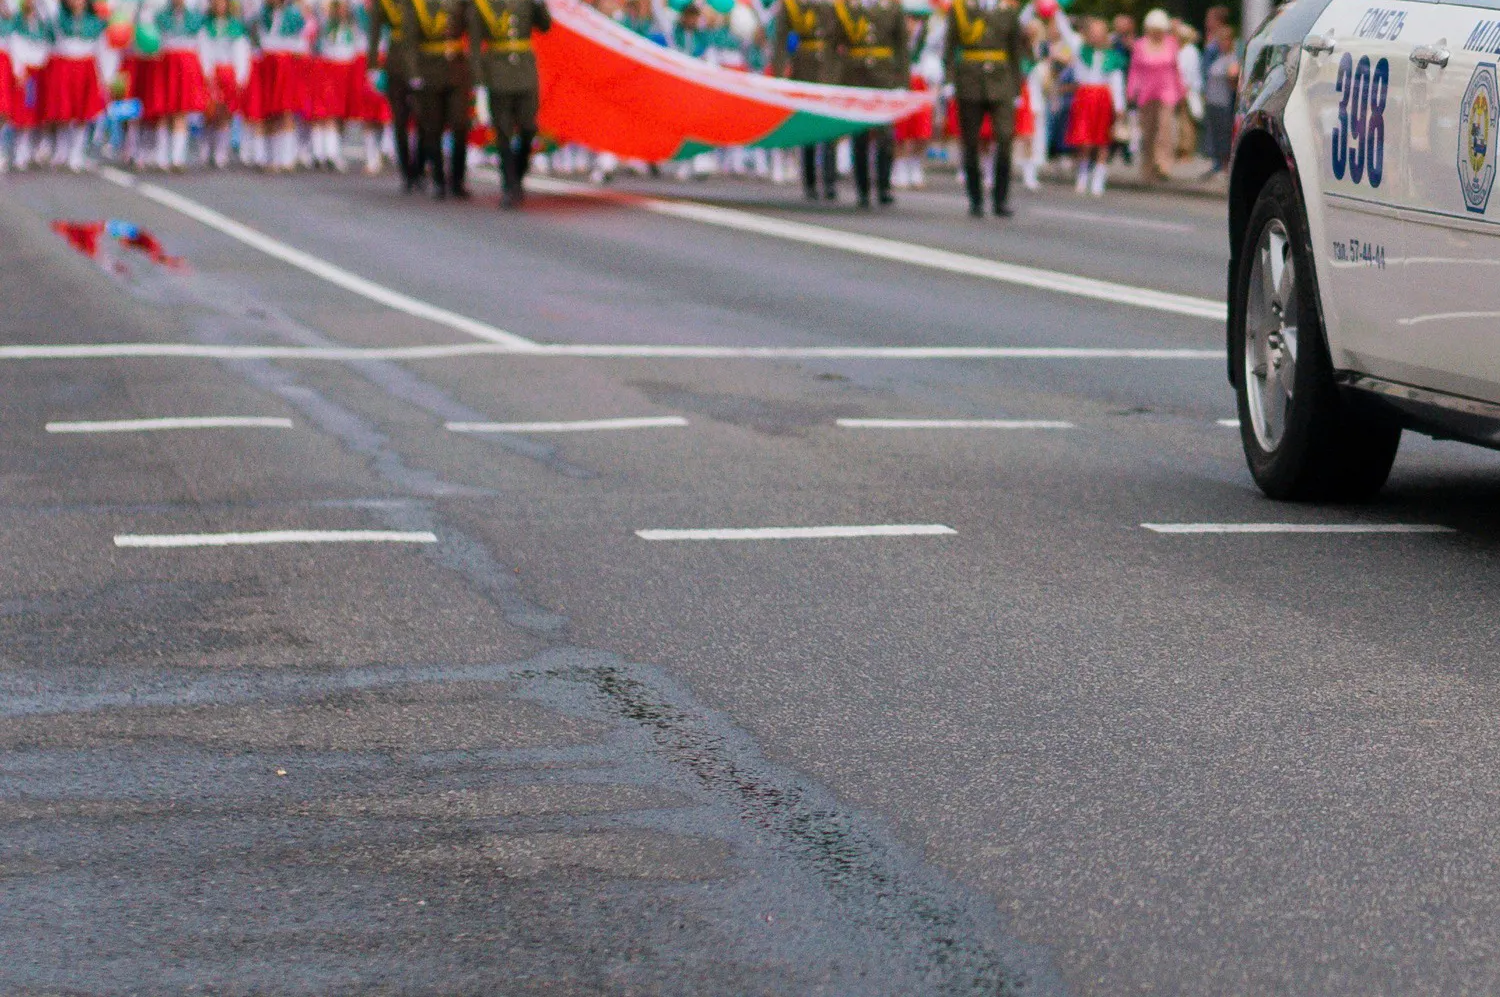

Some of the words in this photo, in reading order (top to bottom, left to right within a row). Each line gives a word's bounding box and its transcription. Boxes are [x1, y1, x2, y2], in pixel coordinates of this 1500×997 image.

[1352, 7, 1408, 41] ГОМЕЛЬ
[1332, 51, 1389, 189] 398
[1350, 238, 1386, 270] 57-44-44
